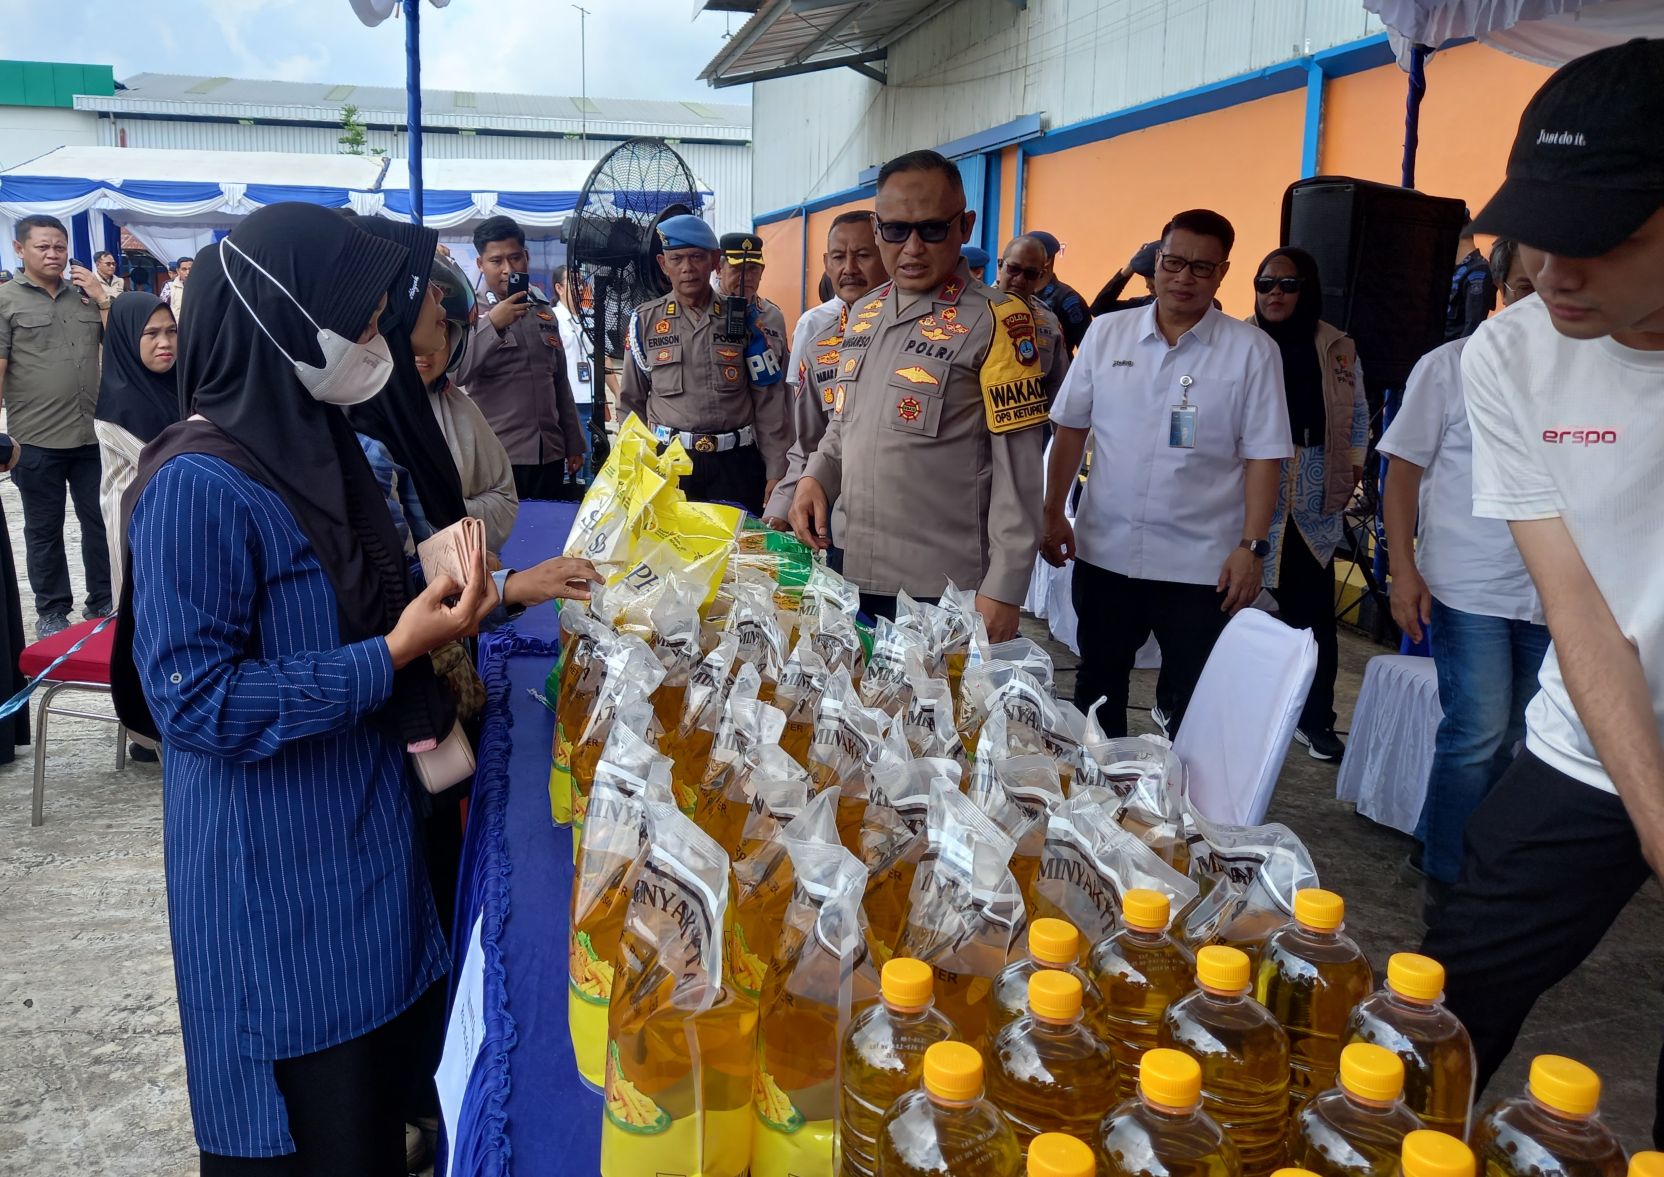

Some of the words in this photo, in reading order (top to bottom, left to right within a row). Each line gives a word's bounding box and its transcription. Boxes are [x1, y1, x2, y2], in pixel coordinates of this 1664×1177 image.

[1536, 129, 1559, 145] Just
[1558, 130, 1573, 145] do
[1006, 315, 1028, 326] POLDA
[648, 335, 680, 348] ERIKSON
[904, 340, 954, 361] POLRI
[995, 412, 1012, 424] OPS
[1542, 430, 1617, 448] erspo
